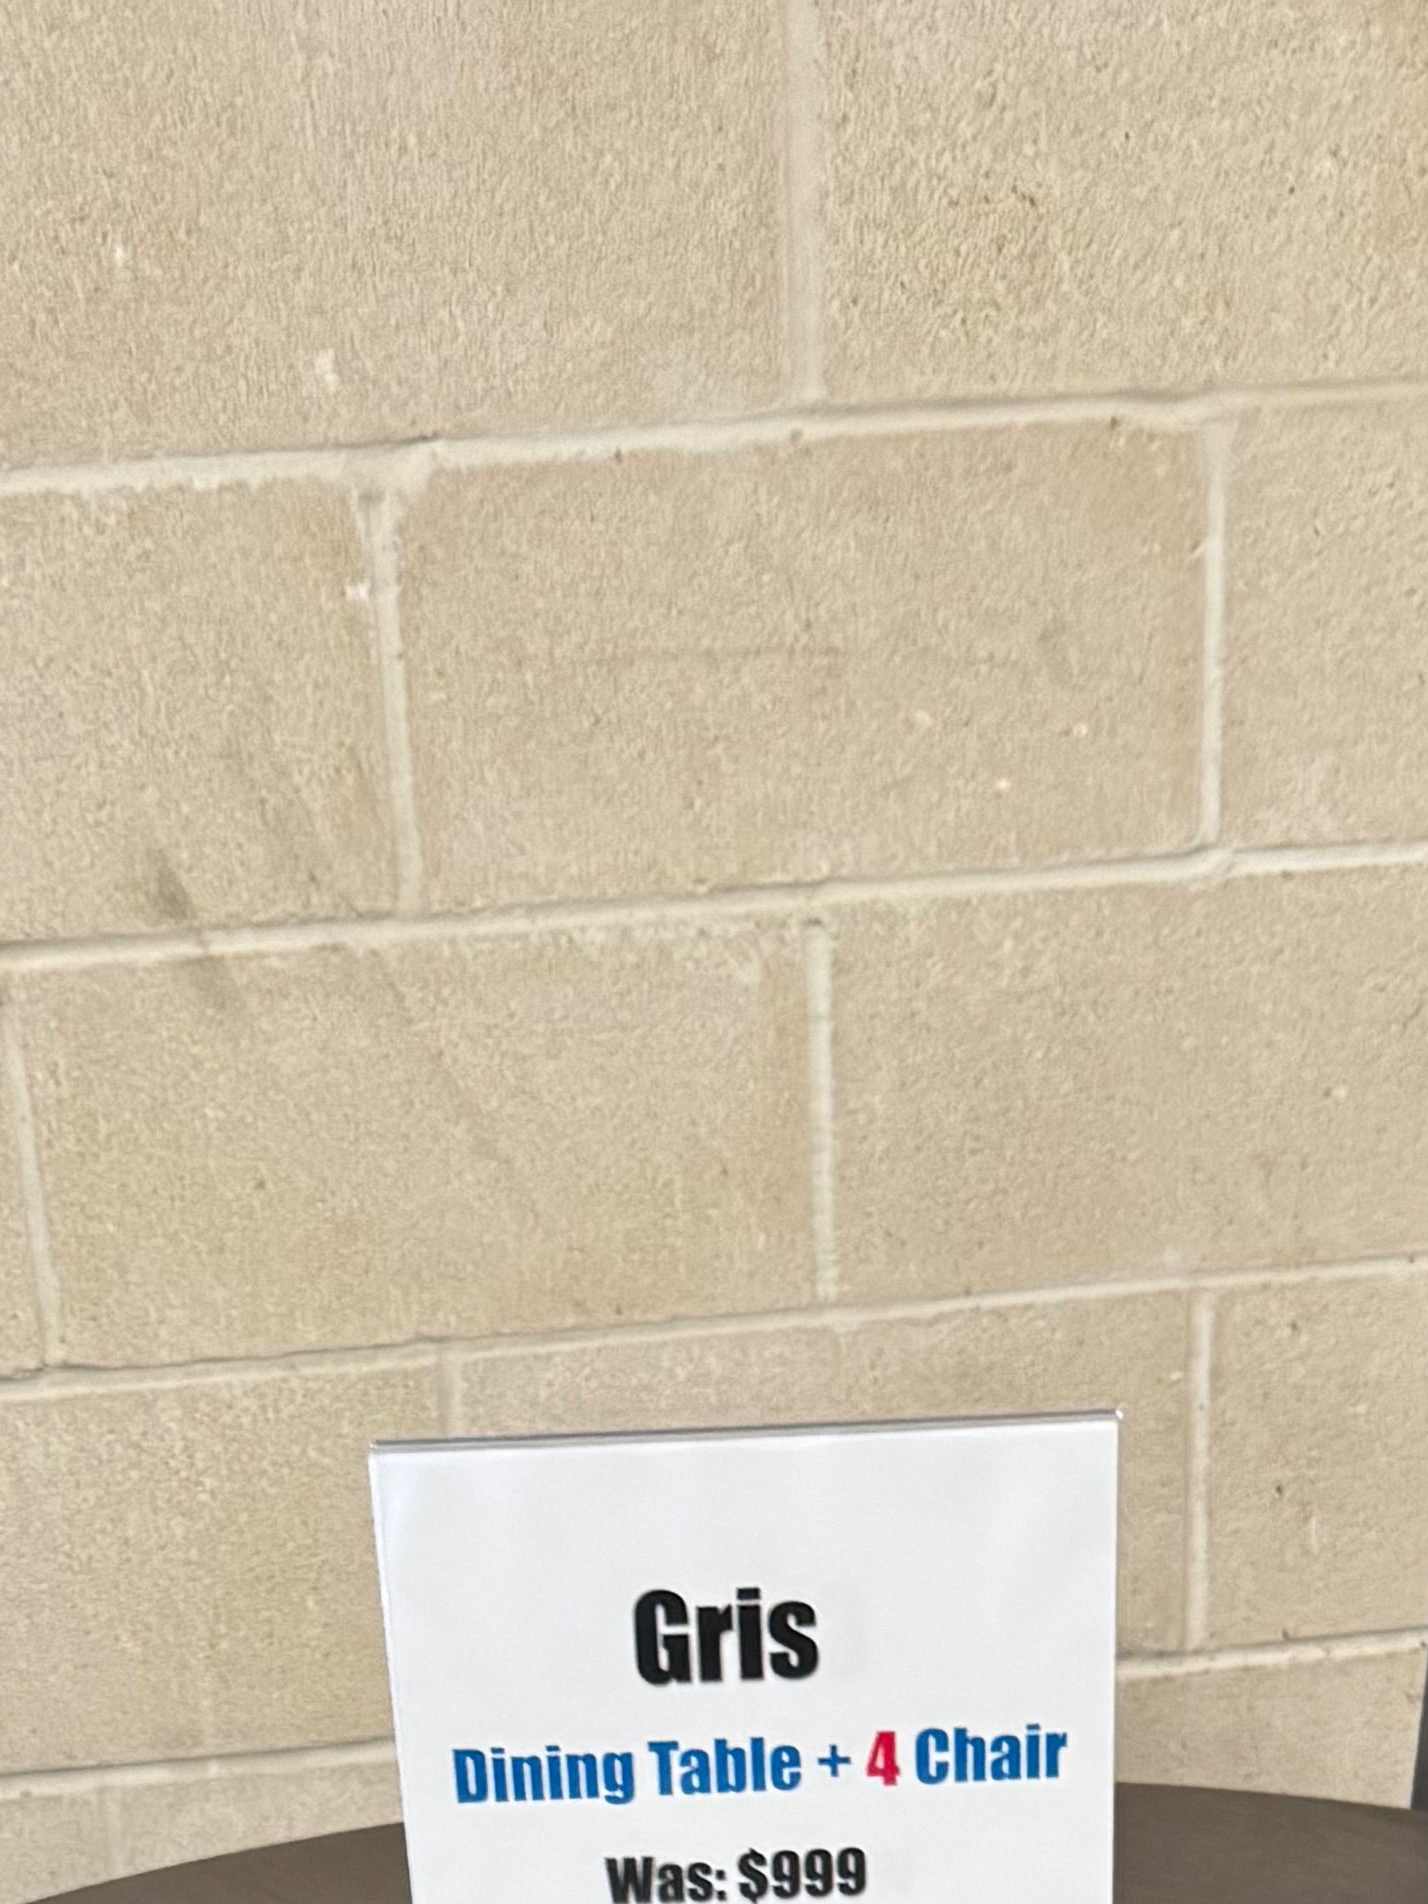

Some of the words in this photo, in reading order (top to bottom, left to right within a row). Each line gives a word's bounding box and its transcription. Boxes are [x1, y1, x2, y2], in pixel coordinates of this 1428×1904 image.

[634, 1588, 820, 1687] Gris
[453, 1746, 636, 1806] Dining
[648, 1738, 803, 1797] Table
[818, 1745, 852, 1778] +
[867, 1732, 901, 1787] 4
[916, 1724, 1069, 1786] Chair
[738, 1848, 868, 1904] $999
